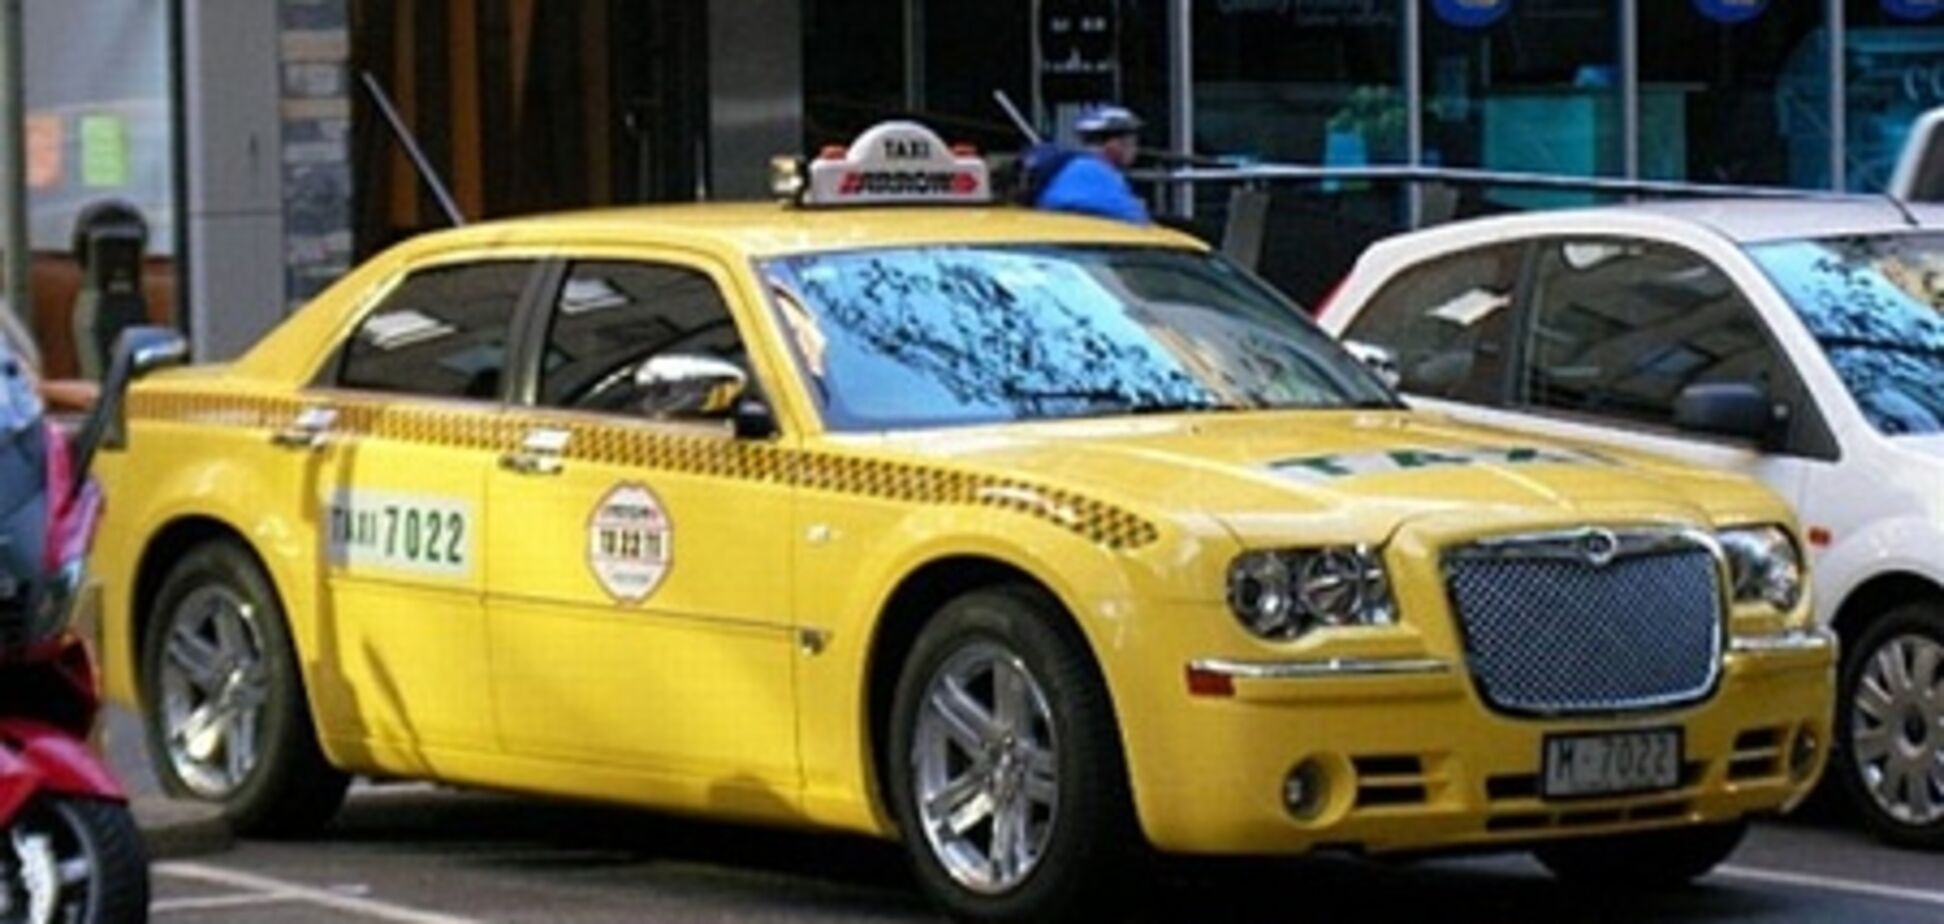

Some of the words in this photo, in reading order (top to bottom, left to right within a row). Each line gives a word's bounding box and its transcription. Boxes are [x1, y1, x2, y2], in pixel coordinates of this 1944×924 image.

[884, 138, 931, 160] TAXI
[331, 505, 377, 546] TAXI
[384, 505, 465, 564] 7022
